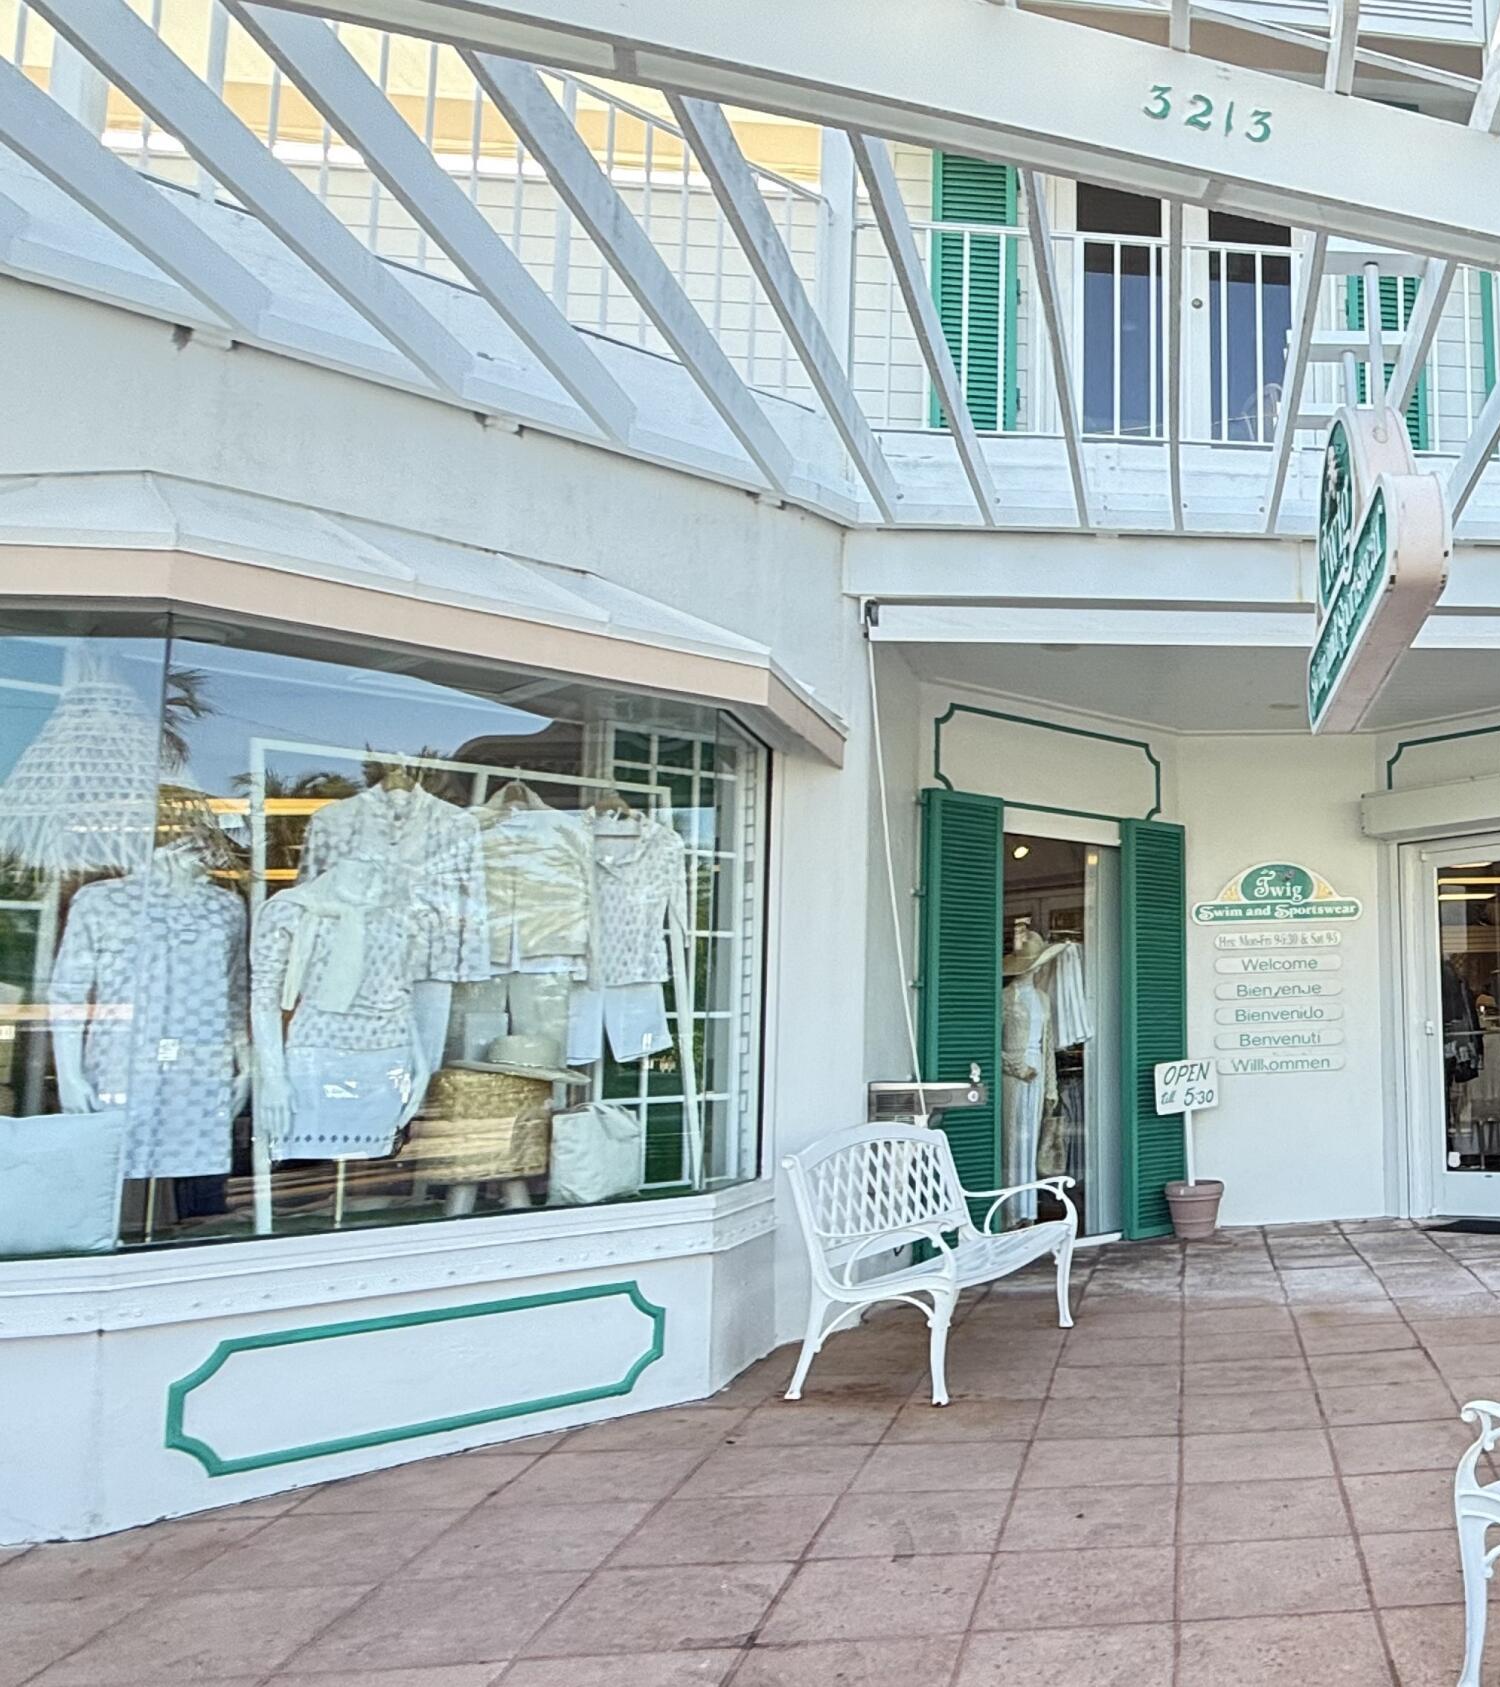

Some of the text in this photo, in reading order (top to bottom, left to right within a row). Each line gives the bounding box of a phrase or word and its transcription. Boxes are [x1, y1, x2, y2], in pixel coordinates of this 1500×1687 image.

[1143, 84, 1273, 143] 3213
[1254, 869, 1303, 901] Twig
[1198, 903, 1356, 921] Swim and Sportswear
[1241, 958, 1318, 972] Welcome
[1235, 1006, 1324, 1022] Bienvenido
[1239, 1032, 1321, 1047] Benvenuti
[1231, 1057, 1331, 1072] Willkommen
[1163, 1061, 1211, 1086] OPEN
